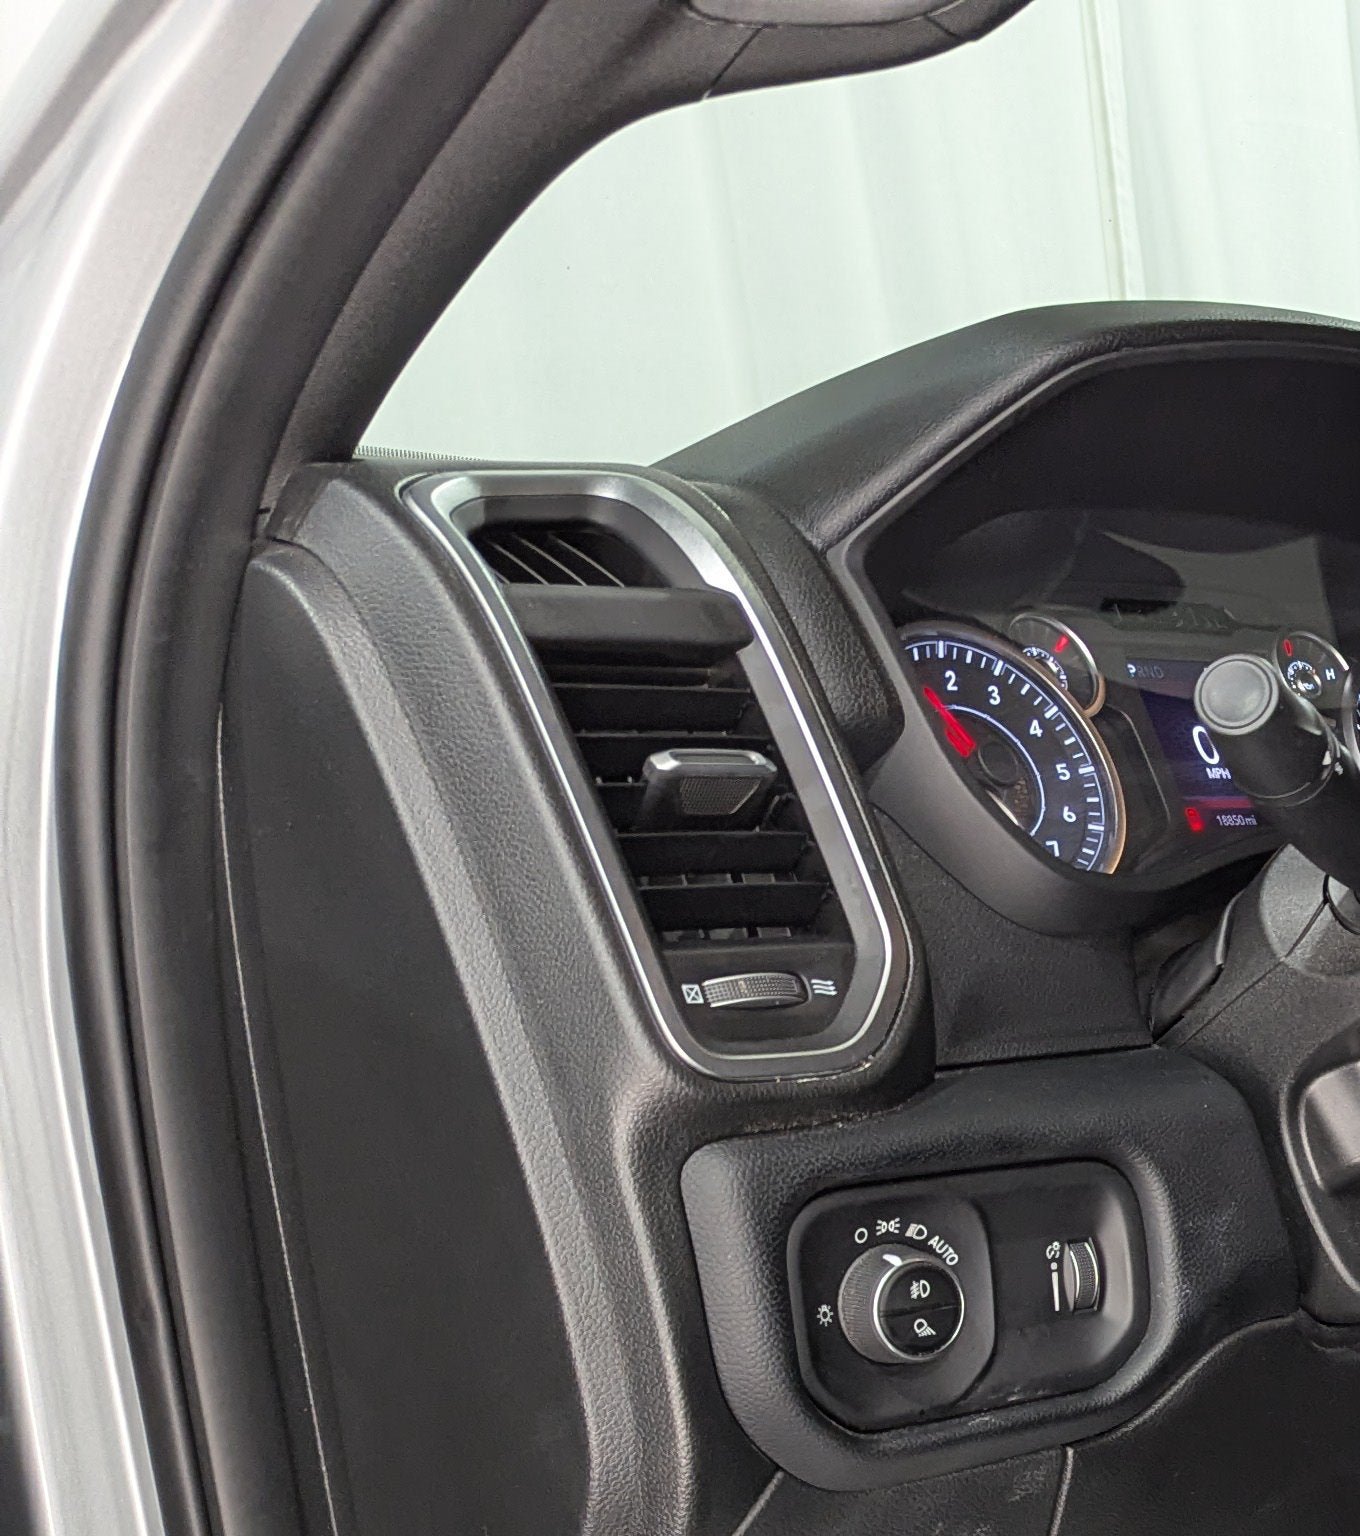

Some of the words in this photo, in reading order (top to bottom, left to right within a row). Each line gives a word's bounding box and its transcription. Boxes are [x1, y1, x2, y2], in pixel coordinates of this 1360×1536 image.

[944, 670, 959, 691] 2
[987, 685, 1001, 706] 3
[1029, 719, 1043, 738] 4
[1055, 763, 1071, 781] 5
[1206, 767, 1232, 780] MPH
[1062, 805, 1077, 823] 6
[1045, 840, 1060, 857] 7
[928, 1235, 959, 1266] AUTO
